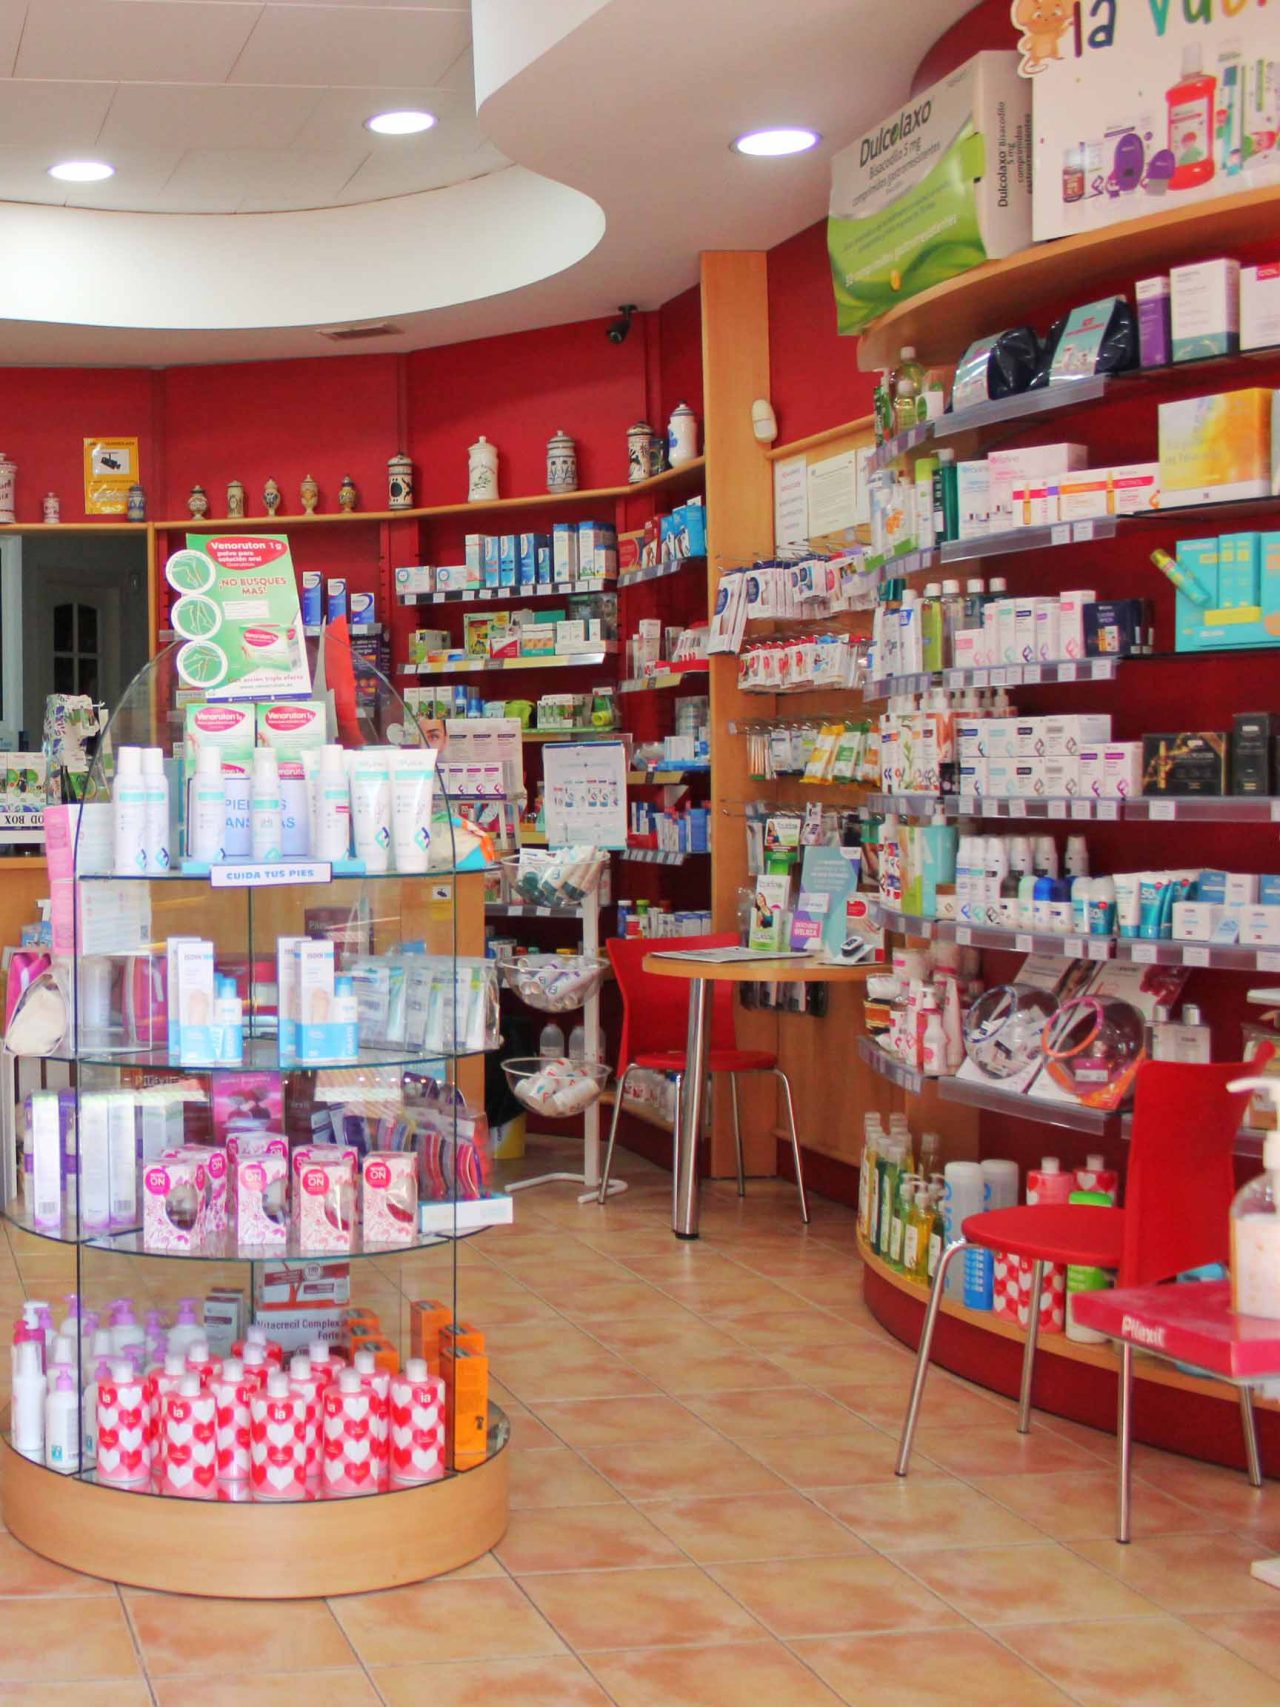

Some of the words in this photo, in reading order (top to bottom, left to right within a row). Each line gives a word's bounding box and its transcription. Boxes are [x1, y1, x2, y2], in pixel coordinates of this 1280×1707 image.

[860, 100, 932, 168] Dulcolaxo
[997, 151, 1008, 208] Dulcolaxo
[210, 542, 266, 550] Venoruton
[240, 577, 286, 586] BUSQUES
[267, 712, 307, 720] Venoruton
[5, 815, 24, 825] BOX
[226, 871, 261, 881] CUIDA
[265, 870, 286, 880] TUS
[289, 869, 315, 879] PIES
[247, 1171, 261, 1183] ON
[370, 1170, 386, 1180] ON
[150, 1175, 165, 1187] ON
[308, 1177, 324, 1188] ON
[1122, 1315, 1166, 1346] Pilexil
[101, 1391, 111, 1403] ia
[420, 1392, 431, 1403] ia
[174, 1407, 184, 1418] ia
[275, 1407, 286, 1419] ia
